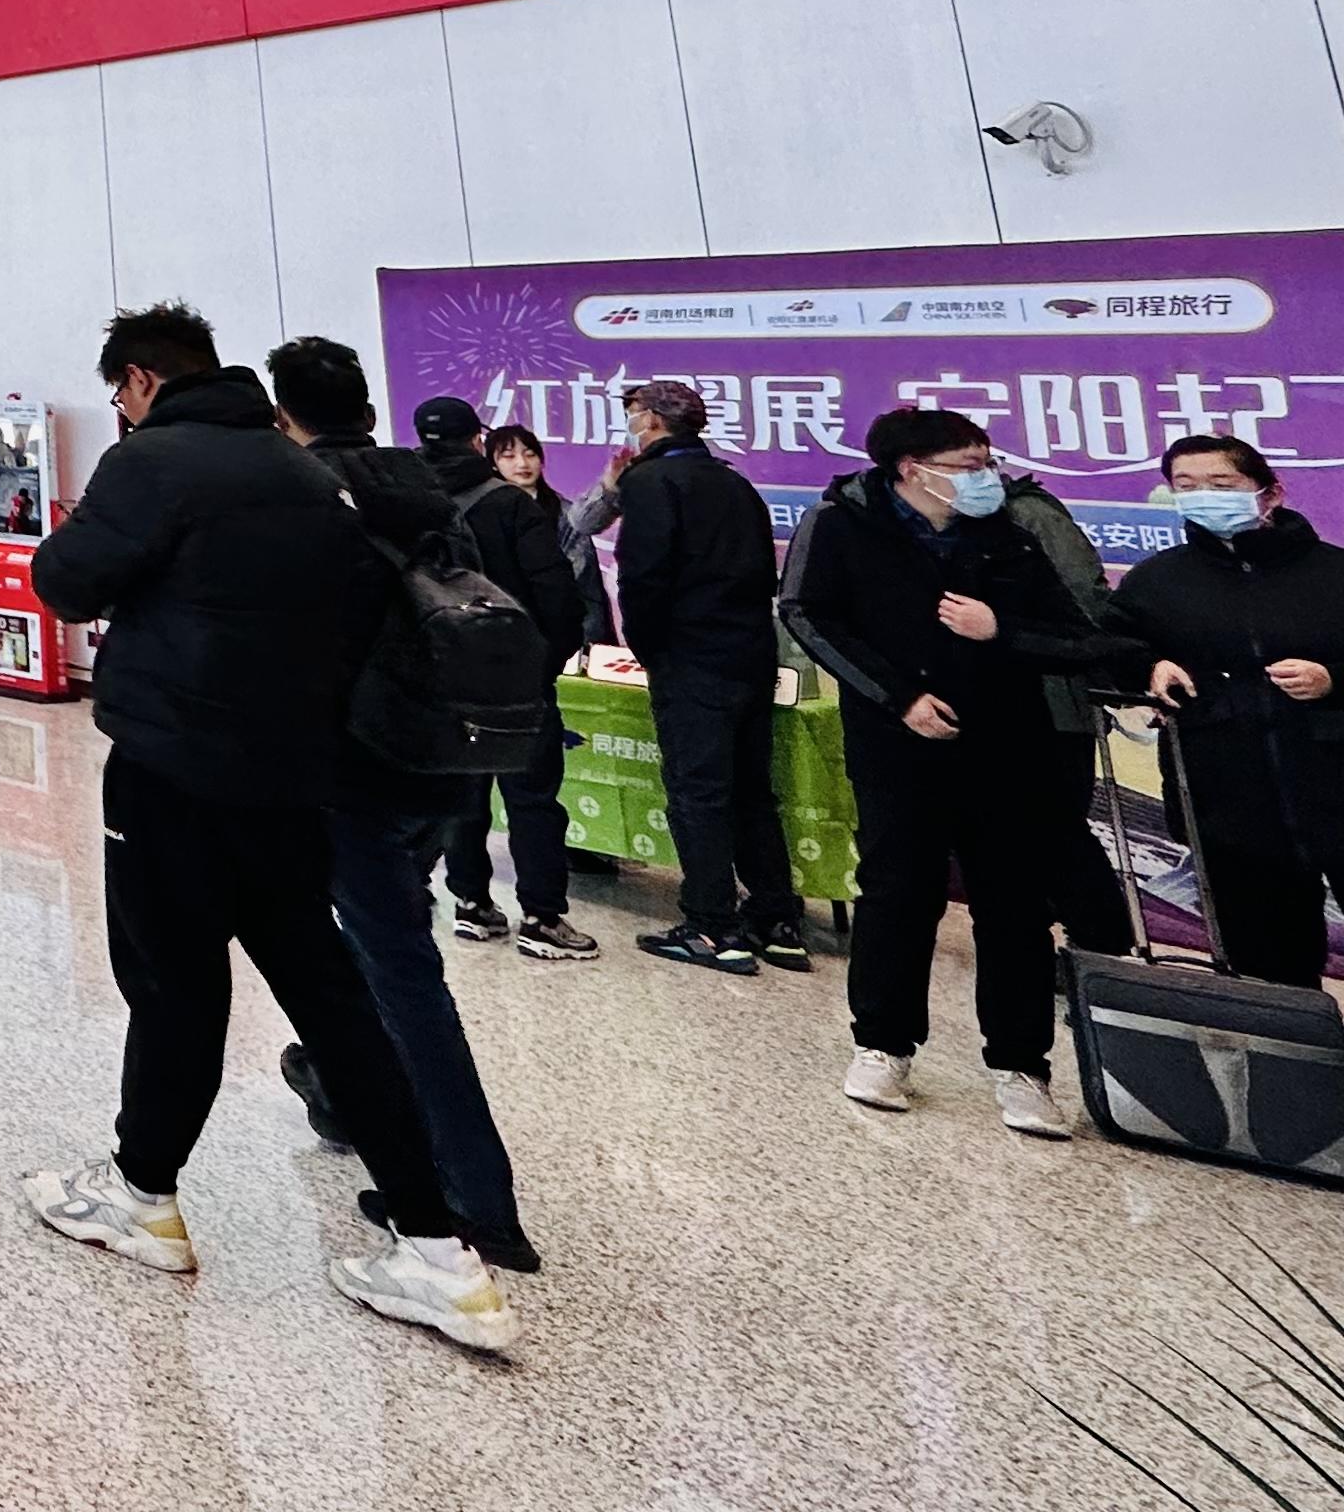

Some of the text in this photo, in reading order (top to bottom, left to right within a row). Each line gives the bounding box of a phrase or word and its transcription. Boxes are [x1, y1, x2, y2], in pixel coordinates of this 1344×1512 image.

[644, 307, 734, 320] 河南机场集团
[921, 301, 1006, 312] 中国南方航空
[1106, 294, 1232, 318] 同程旅行
[897, 373, 1344, 461] 安阳起
[1074, 520, 1189, 552] 飞安阳
